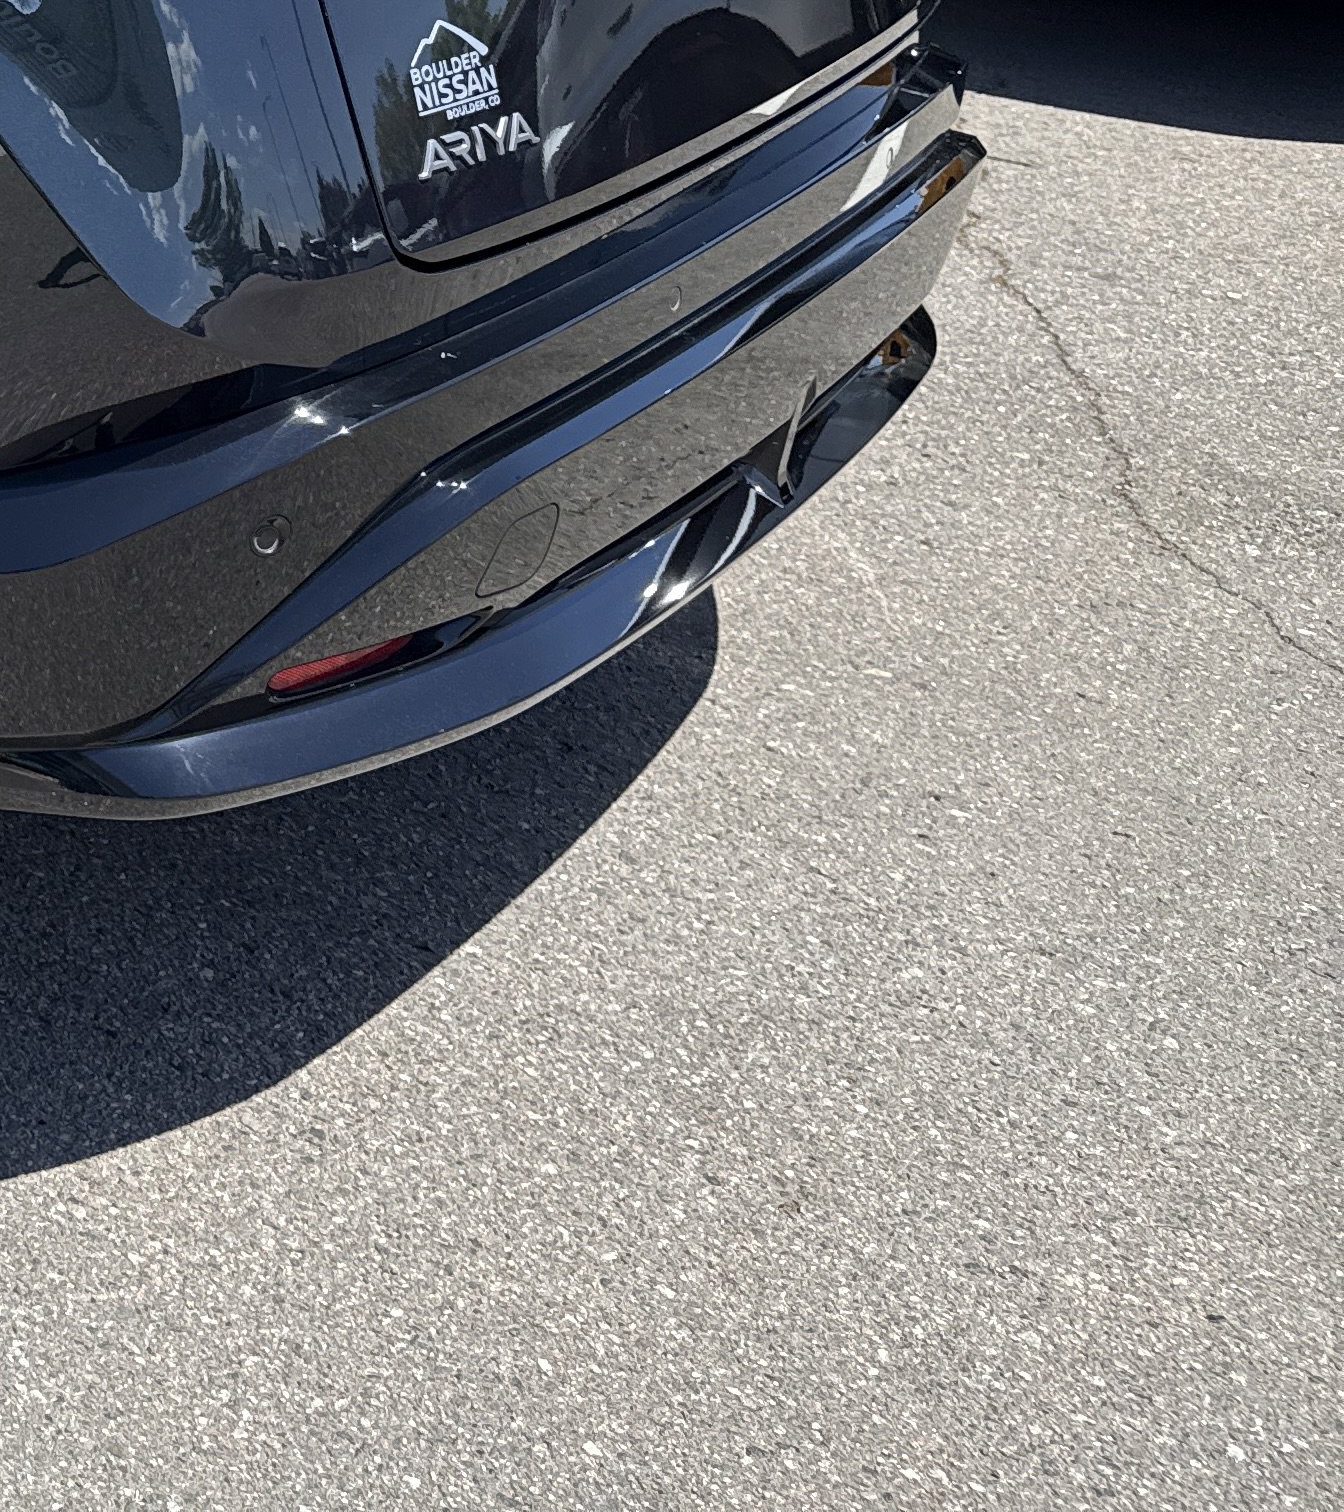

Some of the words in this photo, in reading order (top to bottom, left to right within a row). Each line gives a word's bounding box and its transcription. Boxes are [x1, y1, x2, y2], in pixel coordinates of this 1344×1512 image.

[410, 50, 481, 86] BOULDER
[413, 64, 498, 112] NISSAN
[488, 94, 501, 107] CO
[418, 112, 541, 180] ARIYA
